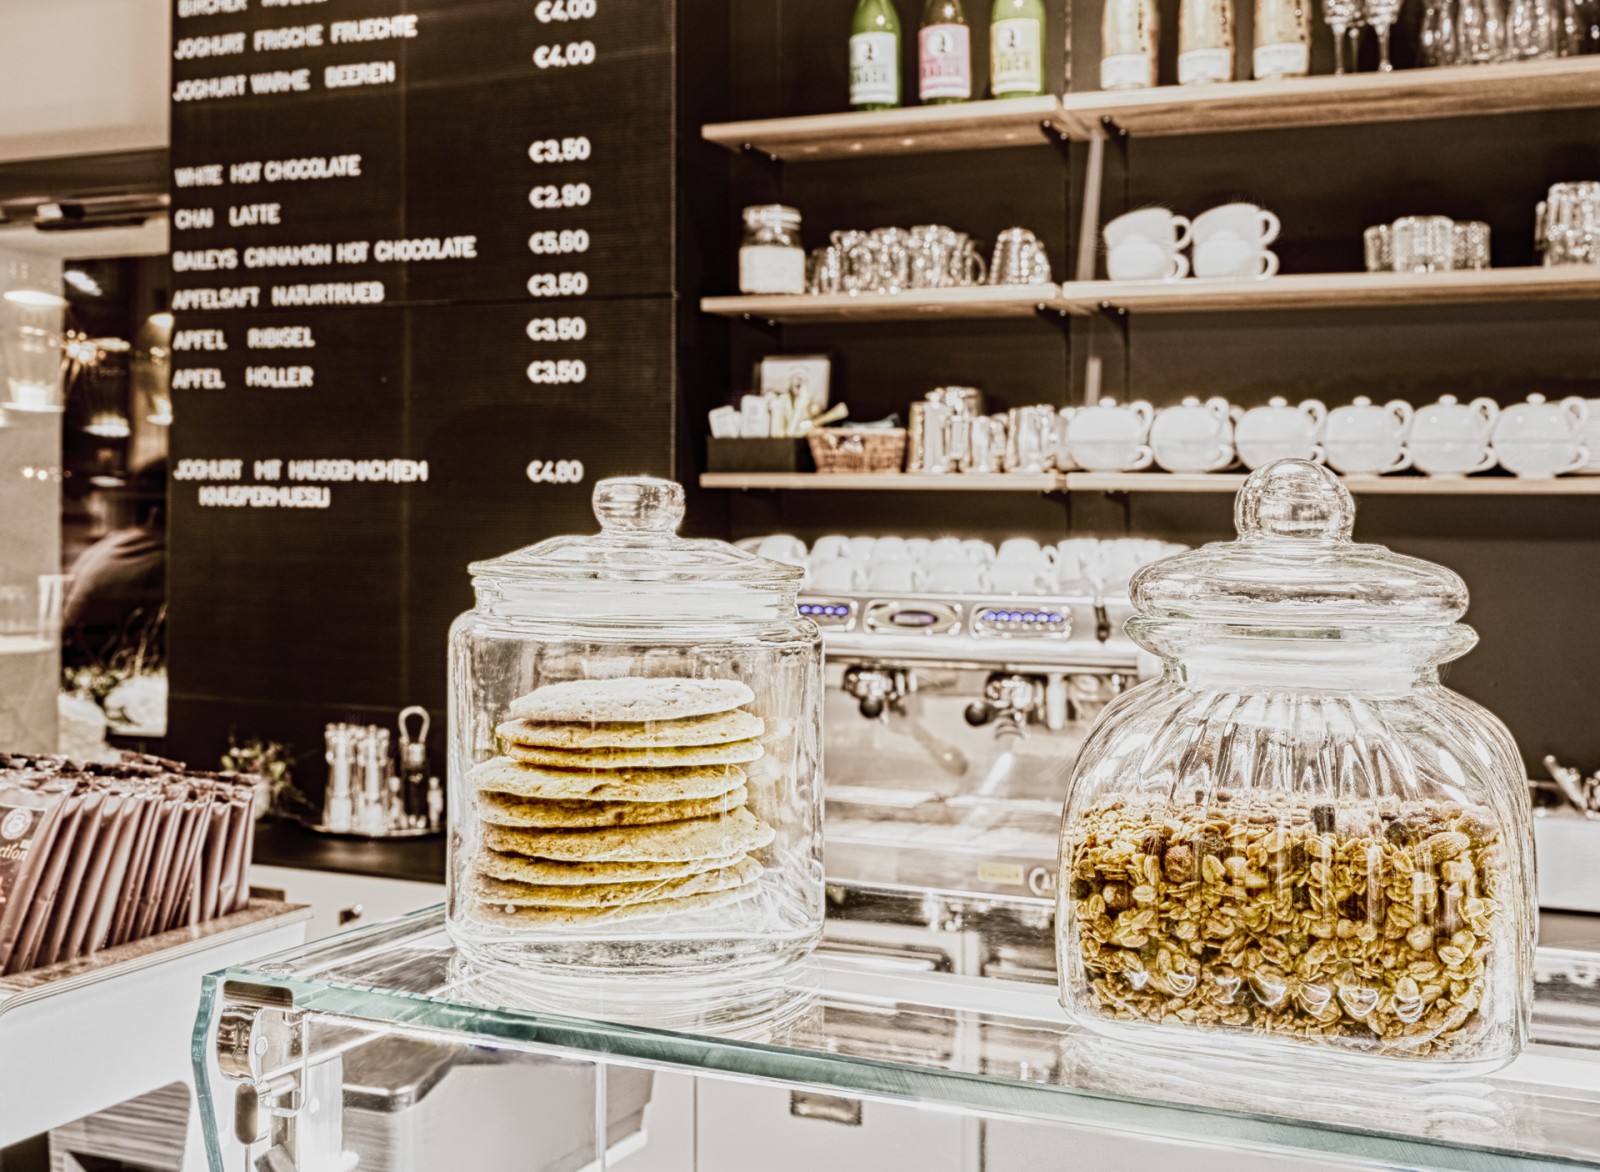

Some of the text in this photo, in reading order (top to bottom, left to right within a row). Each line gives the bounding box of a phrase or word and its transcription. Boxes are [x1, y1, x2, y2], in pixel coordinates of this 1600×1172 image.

[174, 14, 418, 60] JOGHURT FRISCHE FRUECHTE
[173, 75, 247, 101] JOGHURT
[324, 60, 396, 88] BEEREN
[174, 154, 362, 187] WHITE HOT CHOCOLATE
[174, 203, 281, 230] CHAI LATTE
[172, 235, 478, 272] BAILEYS CINNAMON HOT CHOCOLATE
[172, 281, 385, 310] APFELSAFT NATURTRUEB
[173, 329, 228, 350] APFEL
[172, 365, 314, 389] APFEL HOLLER
[174, 459, 243, 481] JOGHURT
[254, 459, 282, 481] MIT
